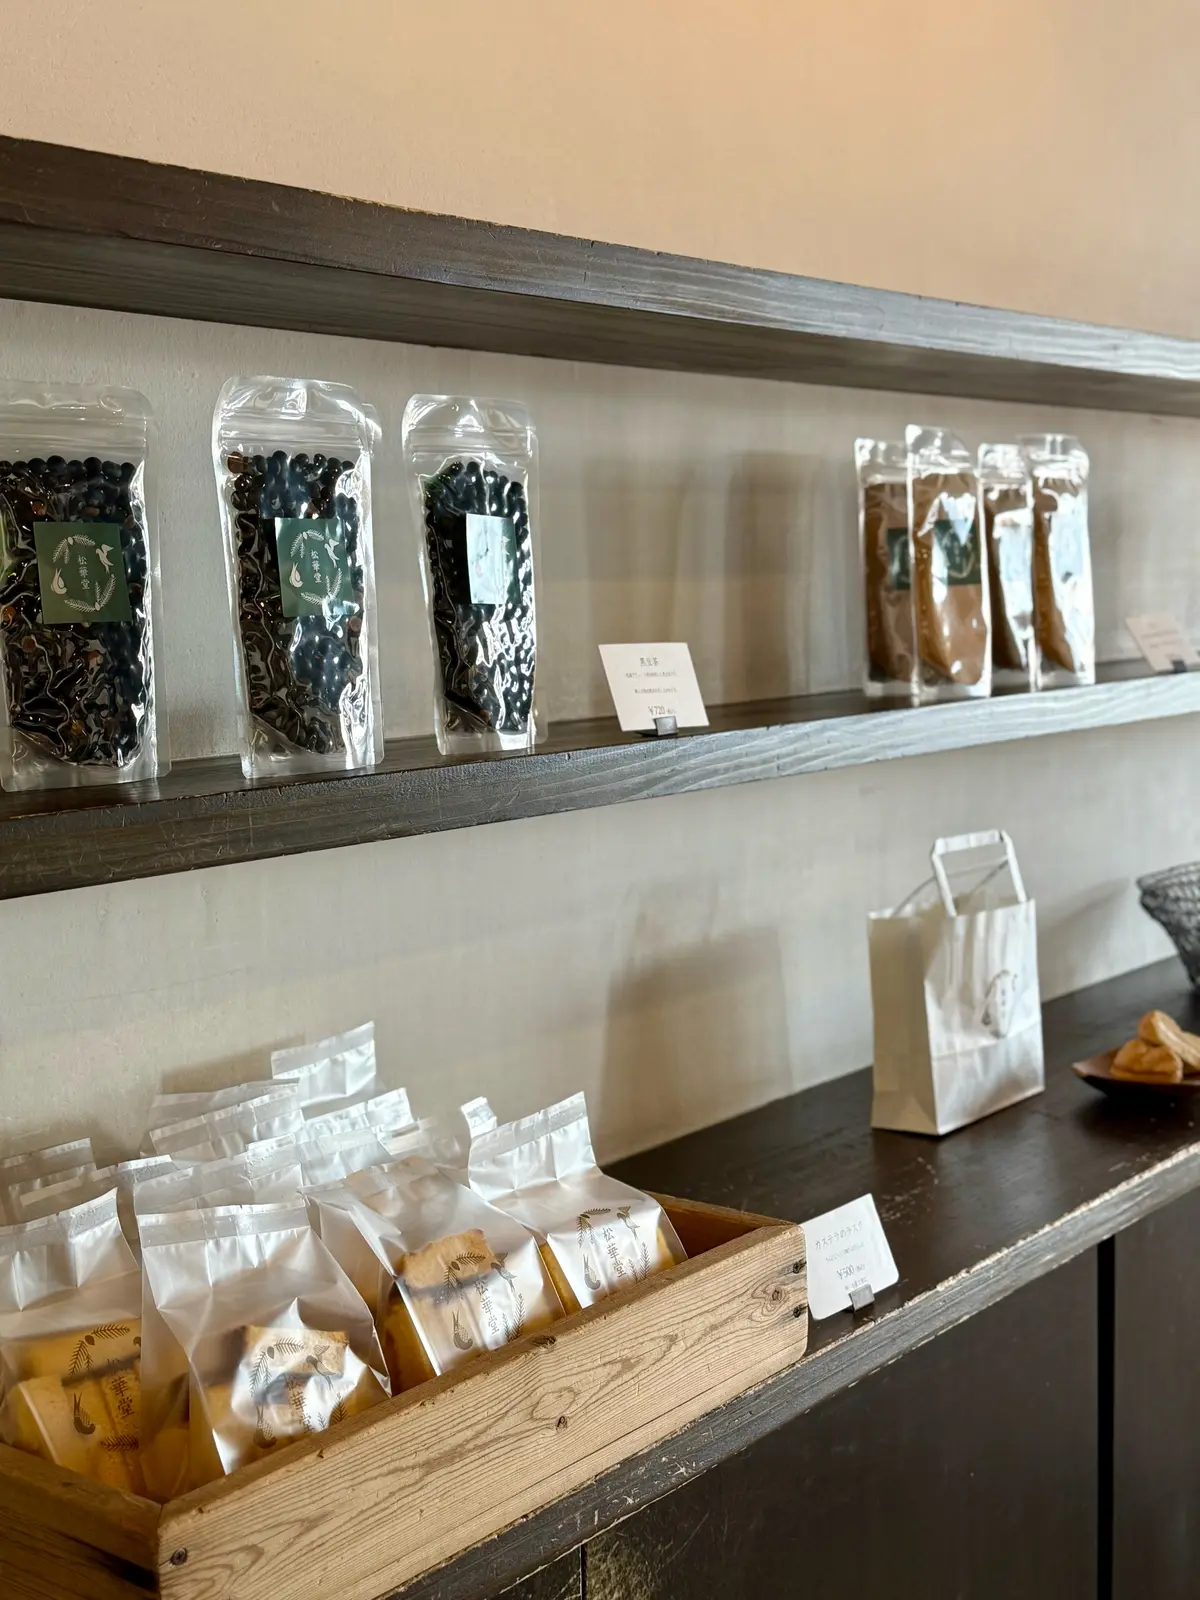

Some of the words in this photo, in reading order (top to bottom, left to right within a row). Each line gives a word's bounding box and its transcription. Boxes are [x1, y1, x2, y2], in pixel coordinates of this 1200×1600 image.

[78, 555, 90, 589] 松華堂
[311, 549, 322, 583] 松華堂
[602, 1227, 627, 1278] 松華堂
[474, 1276, 500, 1335] 松華堂
